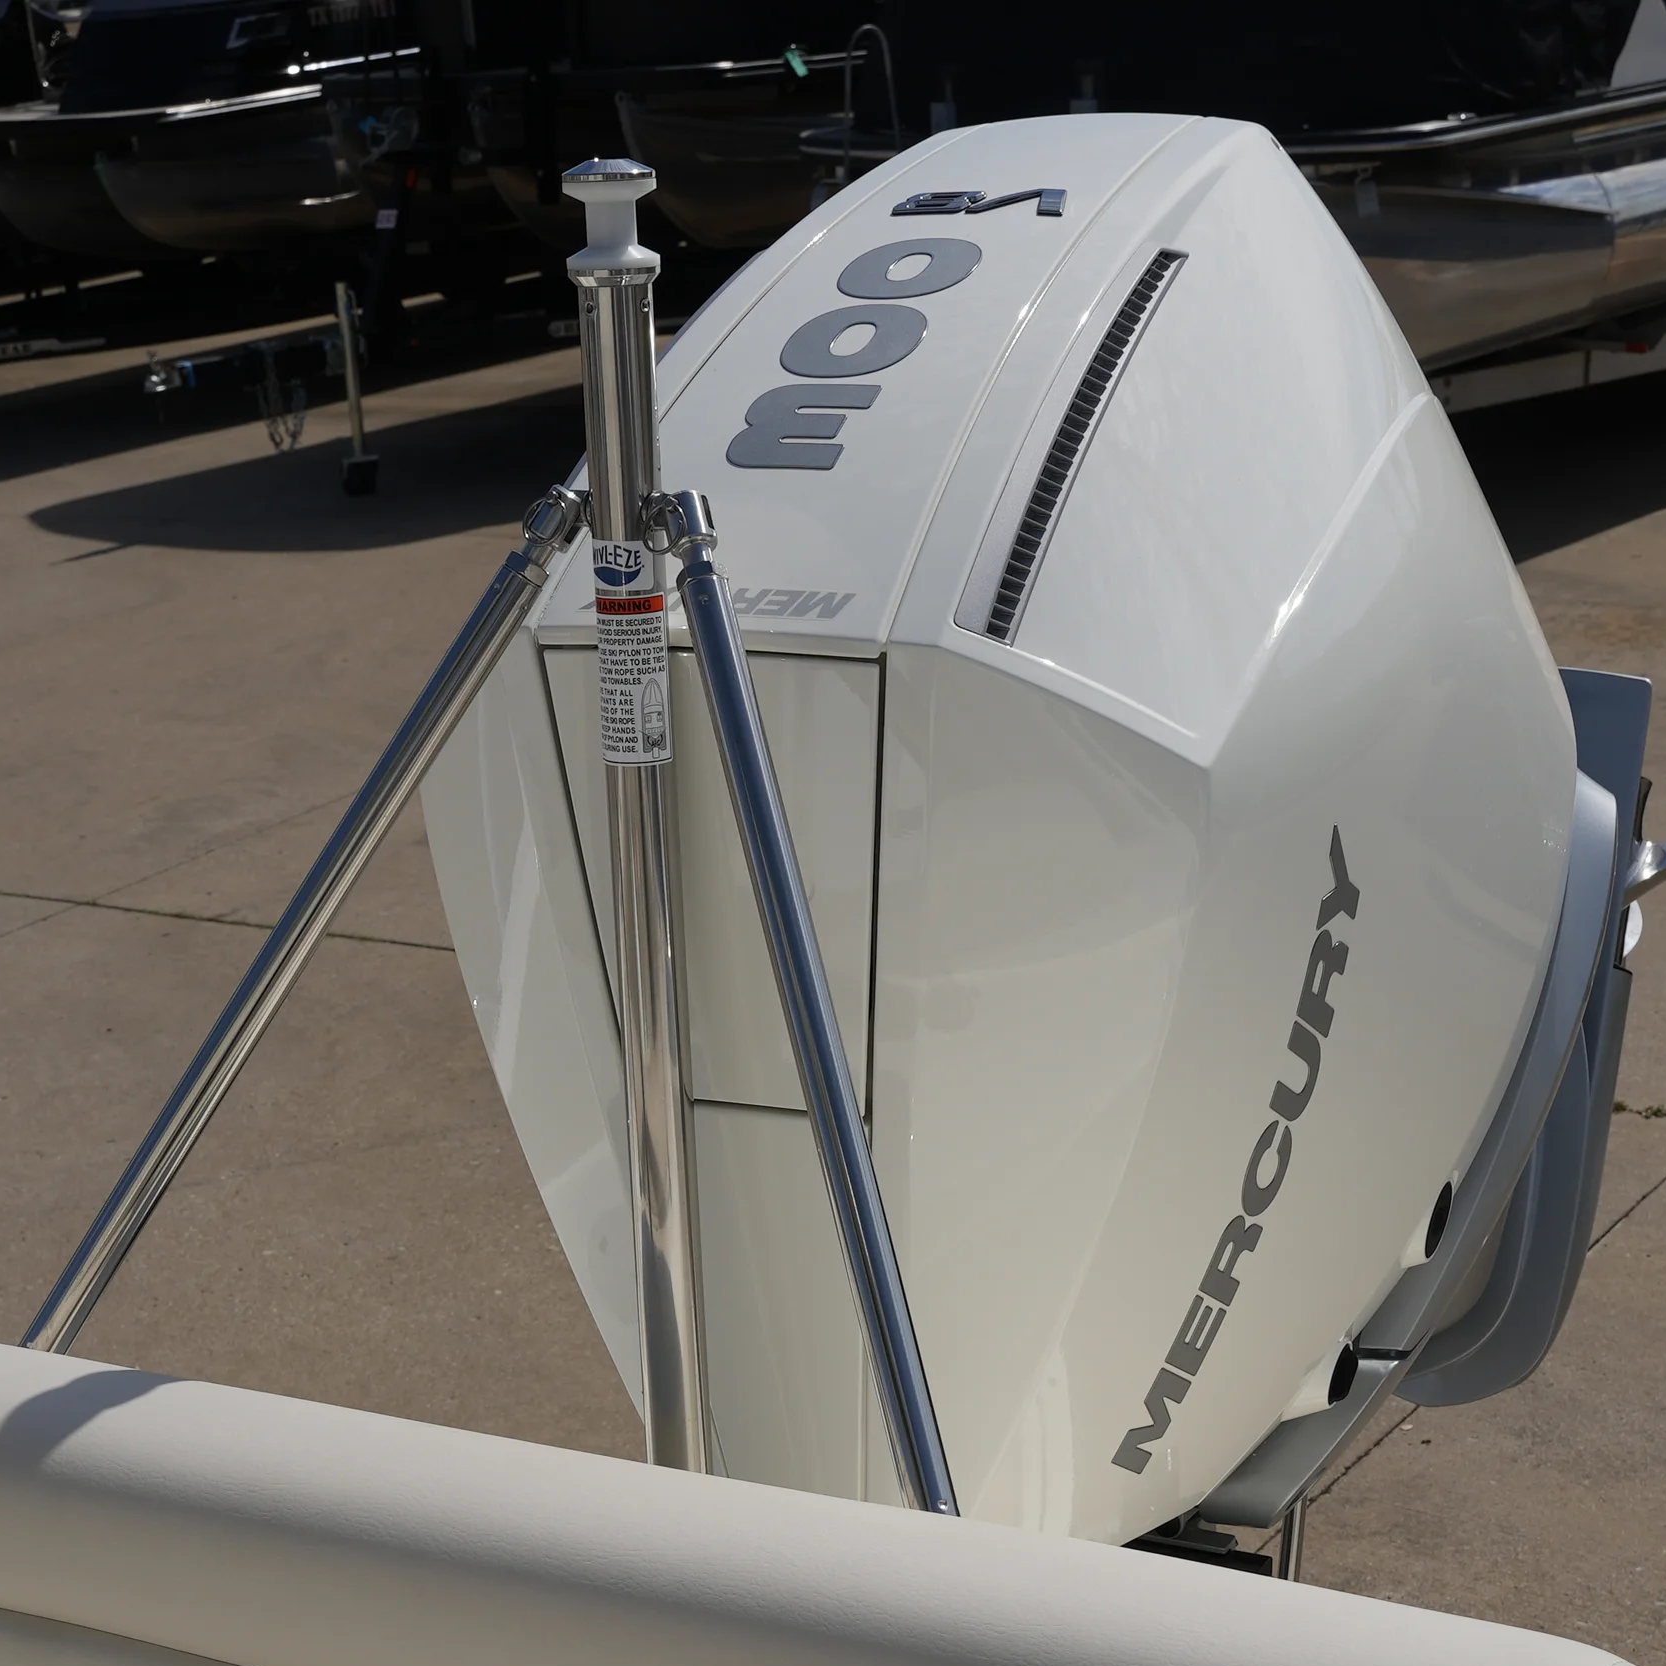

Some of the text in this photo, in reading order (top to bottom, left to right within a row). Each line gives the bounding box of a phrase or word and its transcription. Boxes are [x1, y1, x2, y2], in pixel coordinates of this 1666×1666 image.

[890, 188, 1068, 217] V8
[725, 237, 983, 471] 300
[615, 619, 624, 627] BE
[625, 617, 655, 627] SECURED
[655, 615, 662, 624] TO
[613, 628, 641, 636] SERIOUS
[603, 637, 635, 646] PROPERTY
[618, 649, 641, 657] PYLON
[642, 647, 652, 656] TO
[610, 658, 628, 666] HAVE
[629, 658, 640, 666] TO
[641, 657, 651, 665] BE
[614, 668, 634, 676] ROPE
[636, 667, 657, 675] SUCH
[658, 664, 665, 673] AS
[620, 689, 633, 697] ALL
[619, 698, 634, 706] ARE
[610, 707, 618, 715] OF
[618, 717, 635, 725] ROPE
[612, 726, 636, 734] HANDS
[607, 734, 624, 743] PYLON
[1111, 822, 1361, 1475] MERCURY
